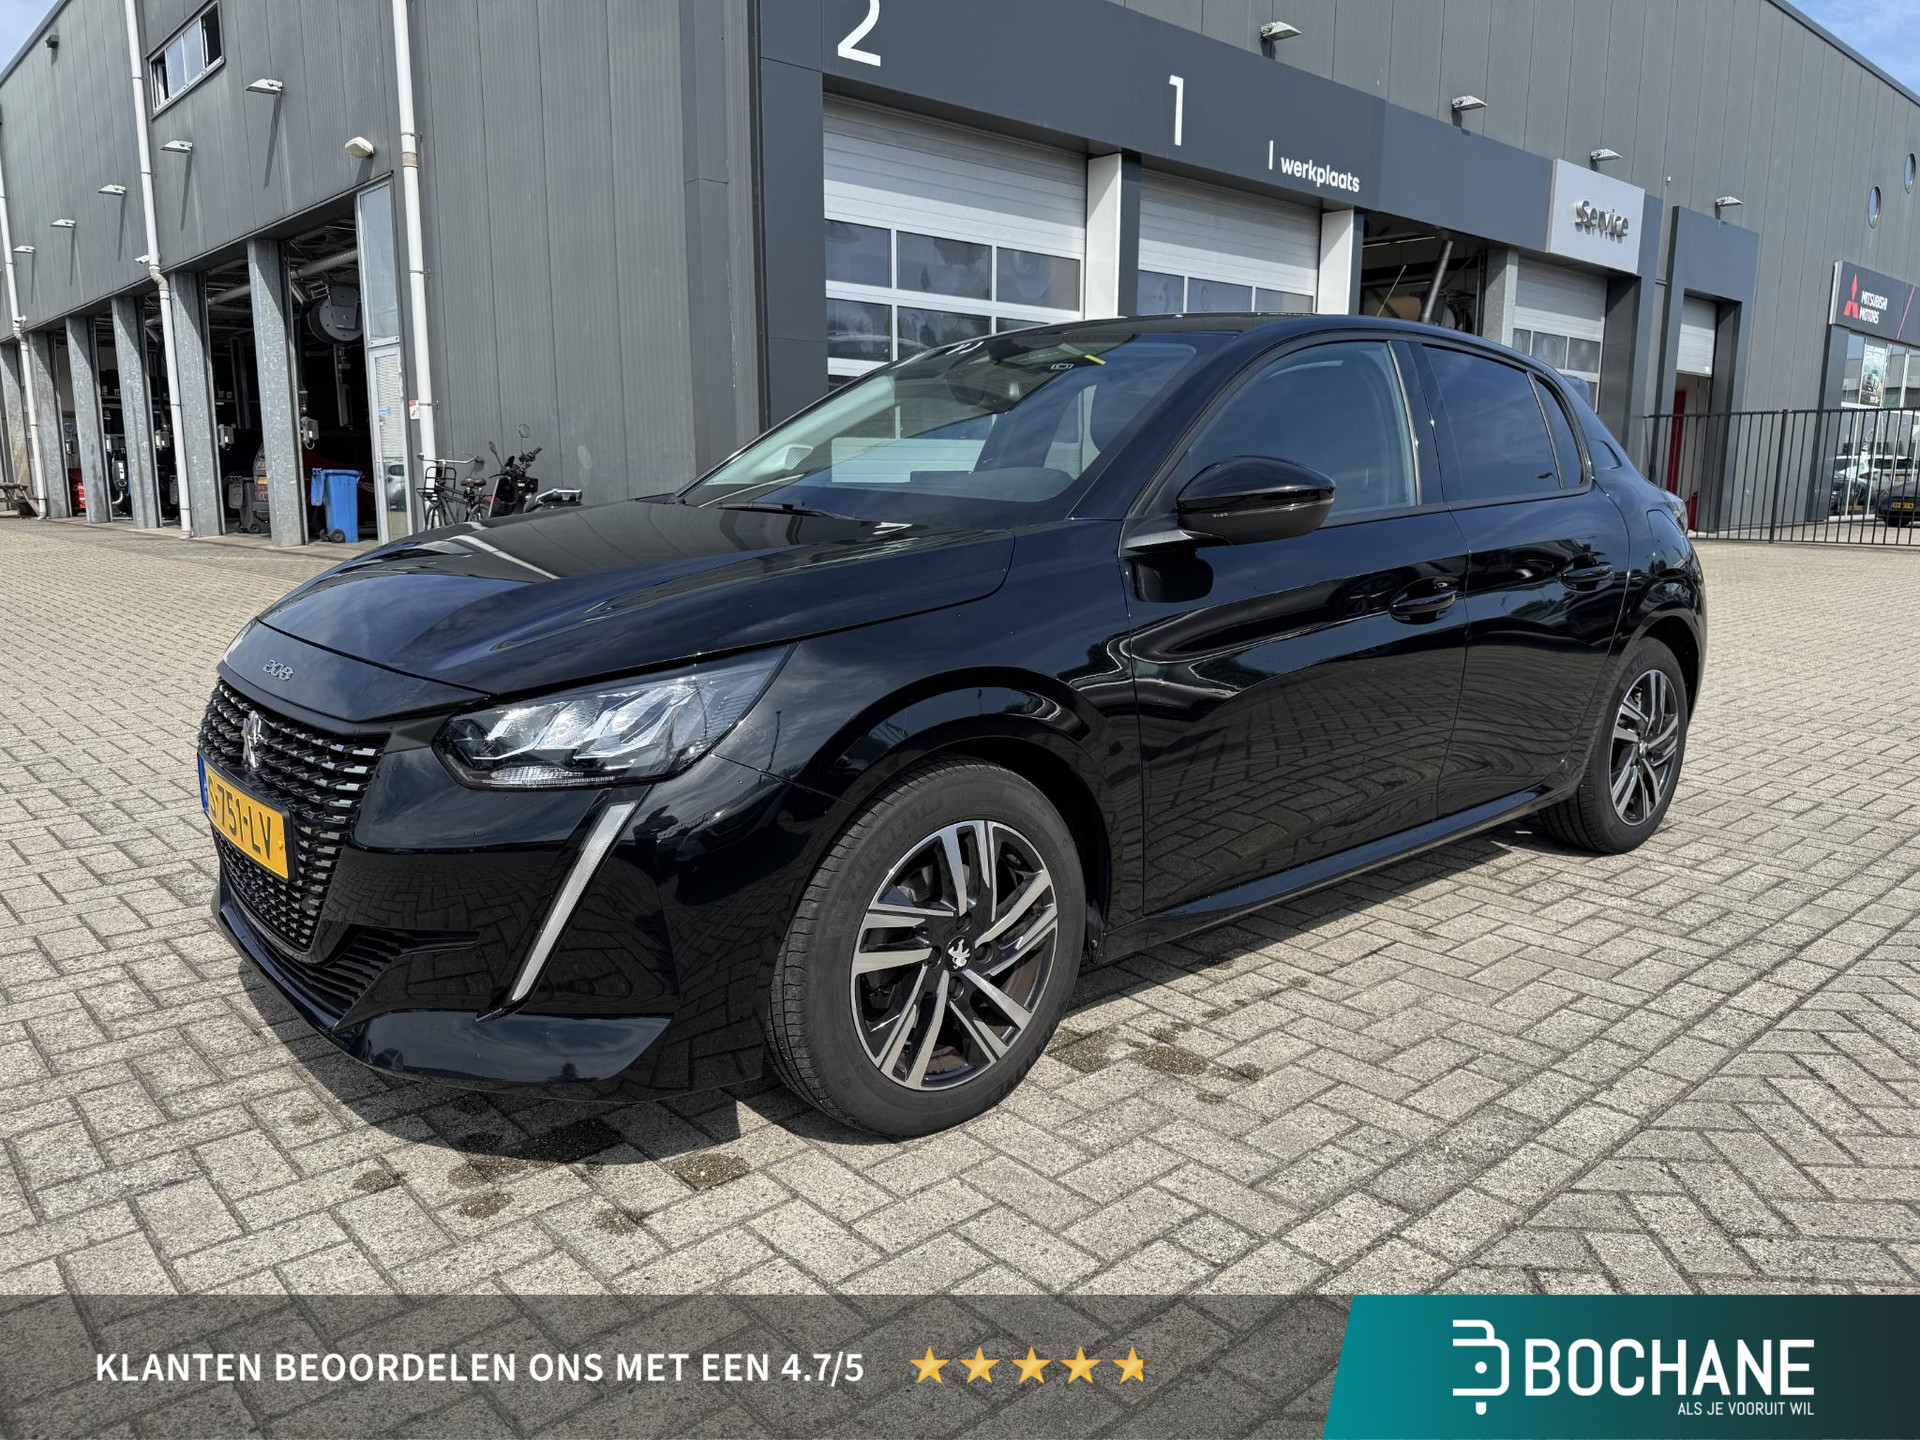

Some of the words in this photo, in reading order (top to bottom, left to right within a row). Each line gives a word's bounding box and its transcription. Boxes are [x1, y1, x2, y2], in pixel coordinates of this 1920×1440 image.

[837, 0, 881, 67] 2
[1169, 75, 1184, 146] 1
[1280, 156, 1360, 193] werkplaats
[1576, 200, 1629, 238] Service
[1859, 306, 1880, 325] MOTORS
[1860, 290, 1888, 311] MITSUBISHI
[262, 659, 294, 681] 208
